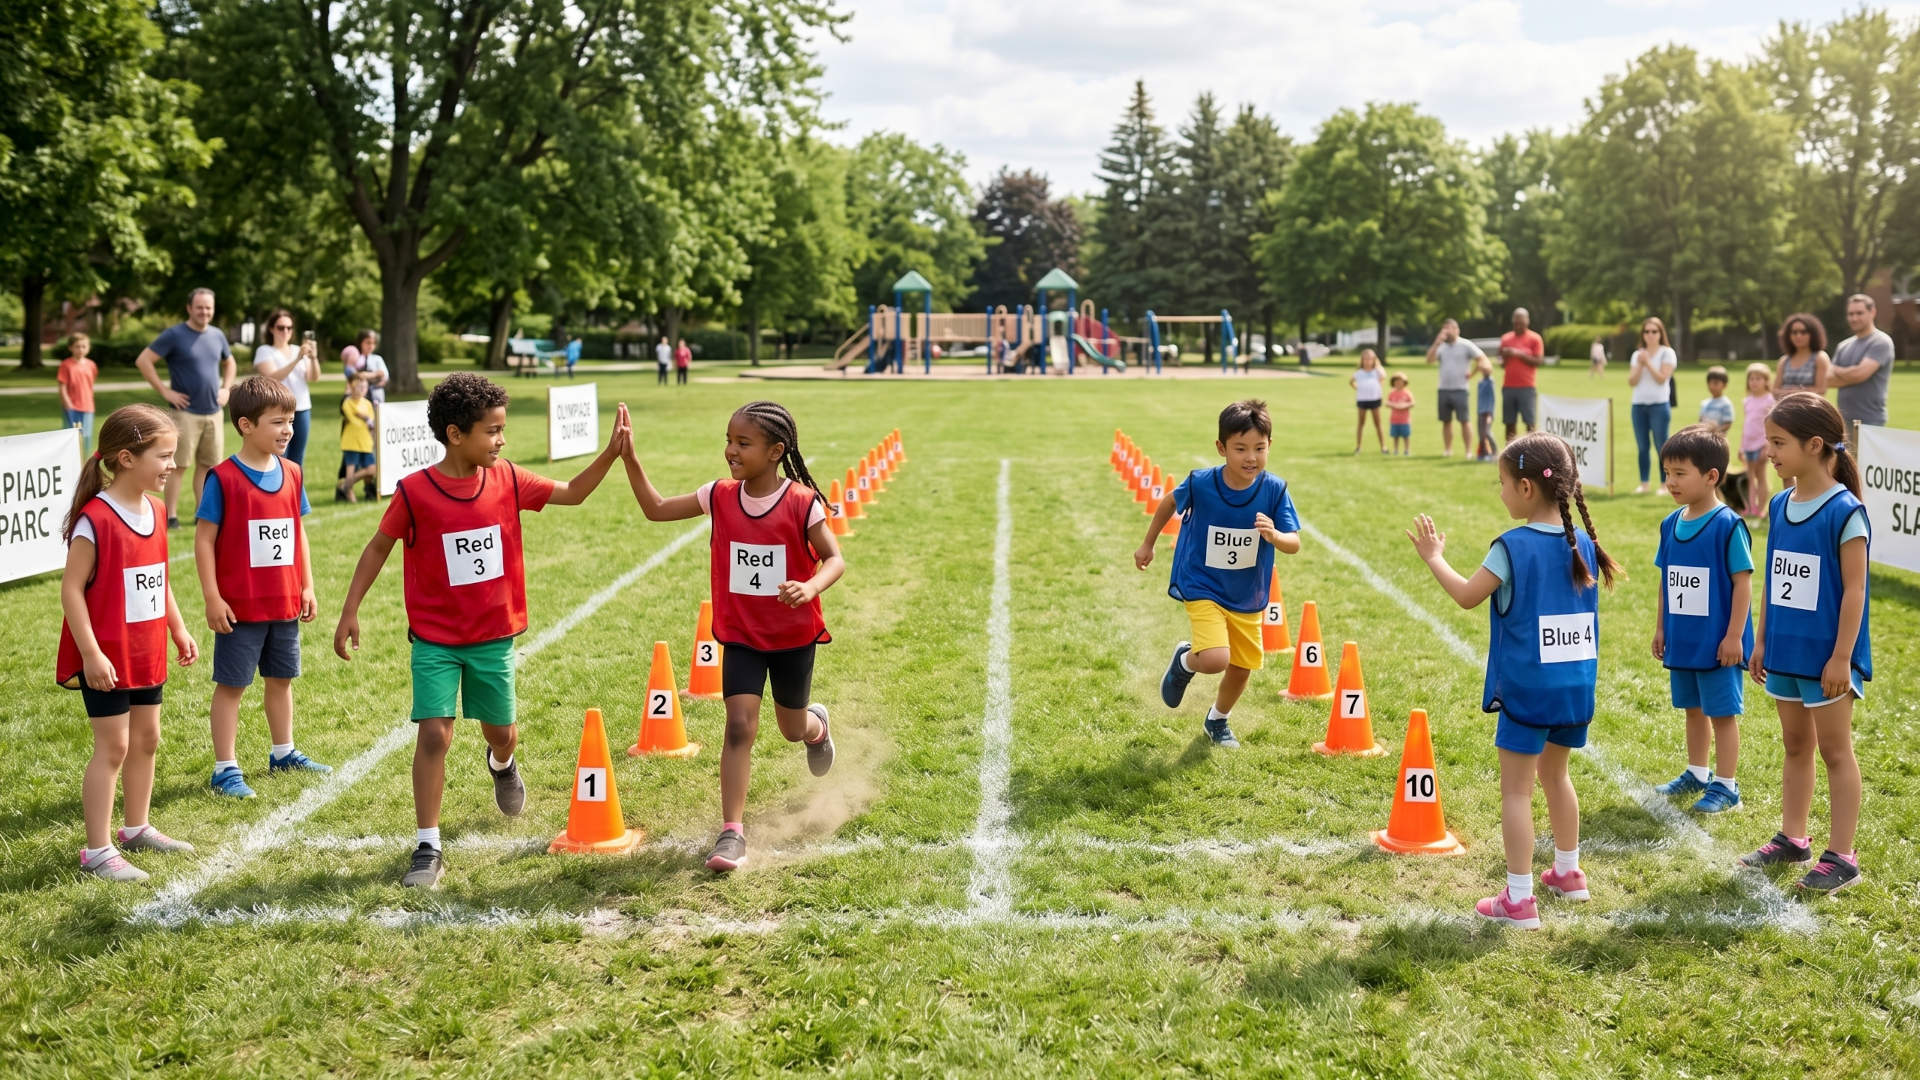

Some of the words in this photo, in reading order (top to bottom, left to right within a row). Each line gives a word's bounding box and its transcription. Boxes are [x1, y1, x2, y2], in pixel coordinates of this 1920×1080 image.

[386, 426, 415, 445] COURSE
[417, 425, 425, 441] DE
[1545, 416, 1597, 442] OLYMPIADE
[401, 445, 438, 468] SLALOM
[0, 465, 62, 504] PIADE
[1865, 464, 1920, 496] COURSE
[0, 506, 49, 546] PARC
[258, 524, 289, 540] Red
[455, 533, 494, 555] Red
[1214, 531, 1252, 547] Blue
[273, 545, 282, 560] 2
[737, 549, 774, 567] Red
[1227, 550, 1237, 565] 3
[473, 558, 485, 576] 3
[1774, 557, 1811, 579] Blue
[136, 572, 163, 590] Red
[750, 572, 761, 590] 4
[1669, 571, 1700, 589] Blue
[1781, 582, 1792, 600] 2
[150, 594, 157, 612] 1
[1676, 592, 1683, 609] 1
[1269, 606, 1279, 622] 5
[1542, 627, 1580, 646] Blue
[1584, 624, 1592, 644] 4
[700, 644, 713, 662] 3
[1306, 646, 1318, 663] 6
[653, 694, 667, 715] 2
[1346, 694, 1360, 715] 7
[584, 774, 596, 797] 1
[1406, 774, 1434, 797] 10
